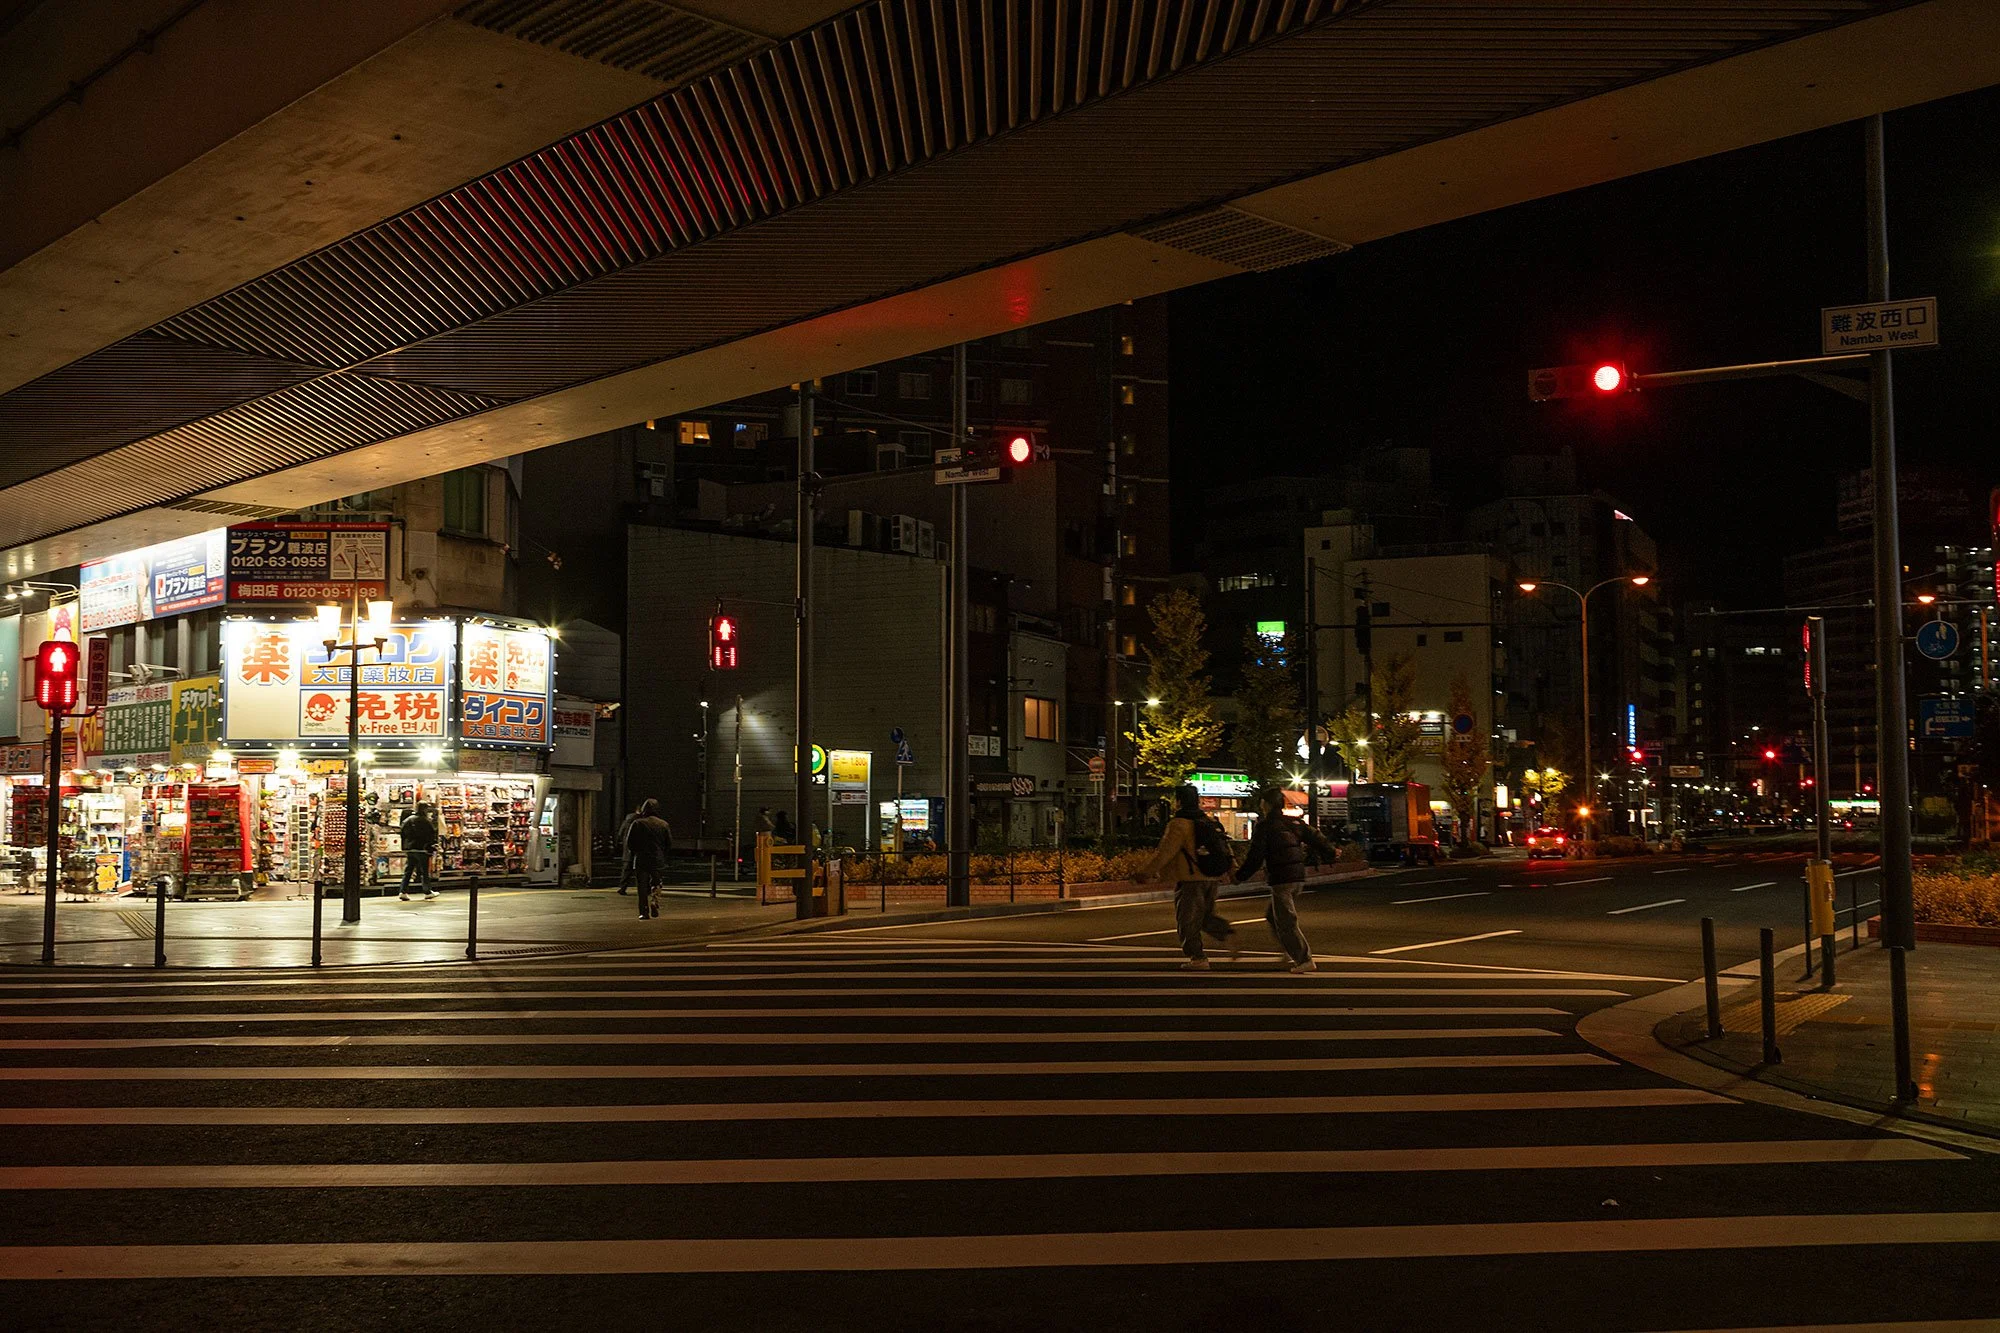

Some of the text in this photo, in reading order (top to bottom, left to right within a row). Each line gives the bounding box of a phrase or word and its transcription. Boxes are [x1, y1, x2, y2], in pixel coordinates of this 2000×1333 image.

[1831, 306, 1926, 333] 難波西口
[1840, 329, 1919, 346] Namba West
[231, 537, 328, 555] プラン 難波店
[231, 556, 327, 568] 0120-63-0955
[165, 576, 189, 597] プラン
[238, 584, 377, 598] 梅田店 0120-09-198
[242, 632, 291, 683] 薬
[469, 640, 498, 685] 薬
[507, 640, 545, 667] 免税
[180, 687, 216, 710] チケット
[345, 692, 440, 721] 免税
[464, 695, 545, 725] ダイコク
[555, 712, 591, 726] 広告募集
[345, 721, 398, 733] Tx-Free
[401, 721, 438, 734] 면세
